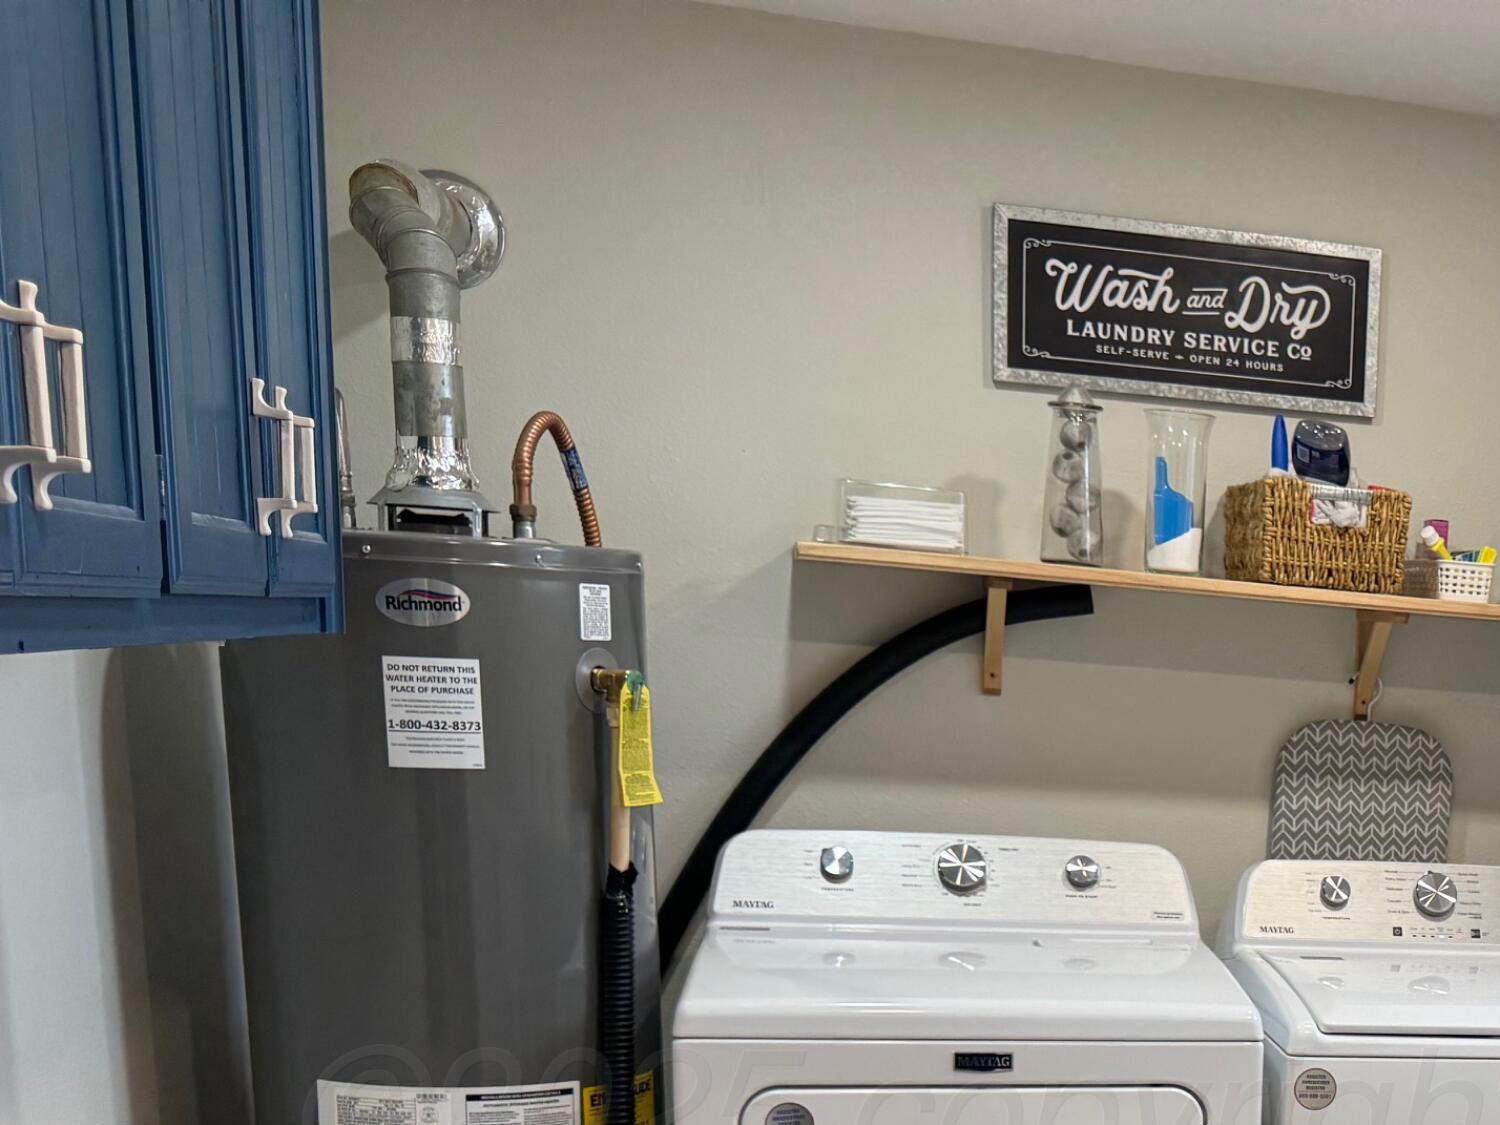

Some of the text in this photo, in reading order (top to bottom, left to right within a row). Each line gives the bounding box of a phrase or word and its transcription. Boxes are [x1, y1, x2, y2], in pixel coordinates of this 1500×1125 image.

[1045, 257, 1331, 341] Wash and Dry
[1066, 319, 1177, 347] LAUNDRY
[1183, 332, 1280, 357] SERVICE
[1095, 344, 1284, 373] SELF-SERVE OPEN 24 HOURS
[385, 595, 462, 613] Richmond
[387, 663, 476, 674] DO NOT RETURN THIS
[385, 674, 414, 683] WATER
[416, 675, 448, 684] HEATER
[462, 677, 478, 685] THE
[391, 685, 474, 695] PLACE OF PURCHASE
[388, 719, 481, 731] 1-800-432-8373
[733, 900, 775, 909] MAYTAG
[1259, 926, 1294, 934] MAYTAG
[956, 1055, 1012, 1069] MAYTAG
